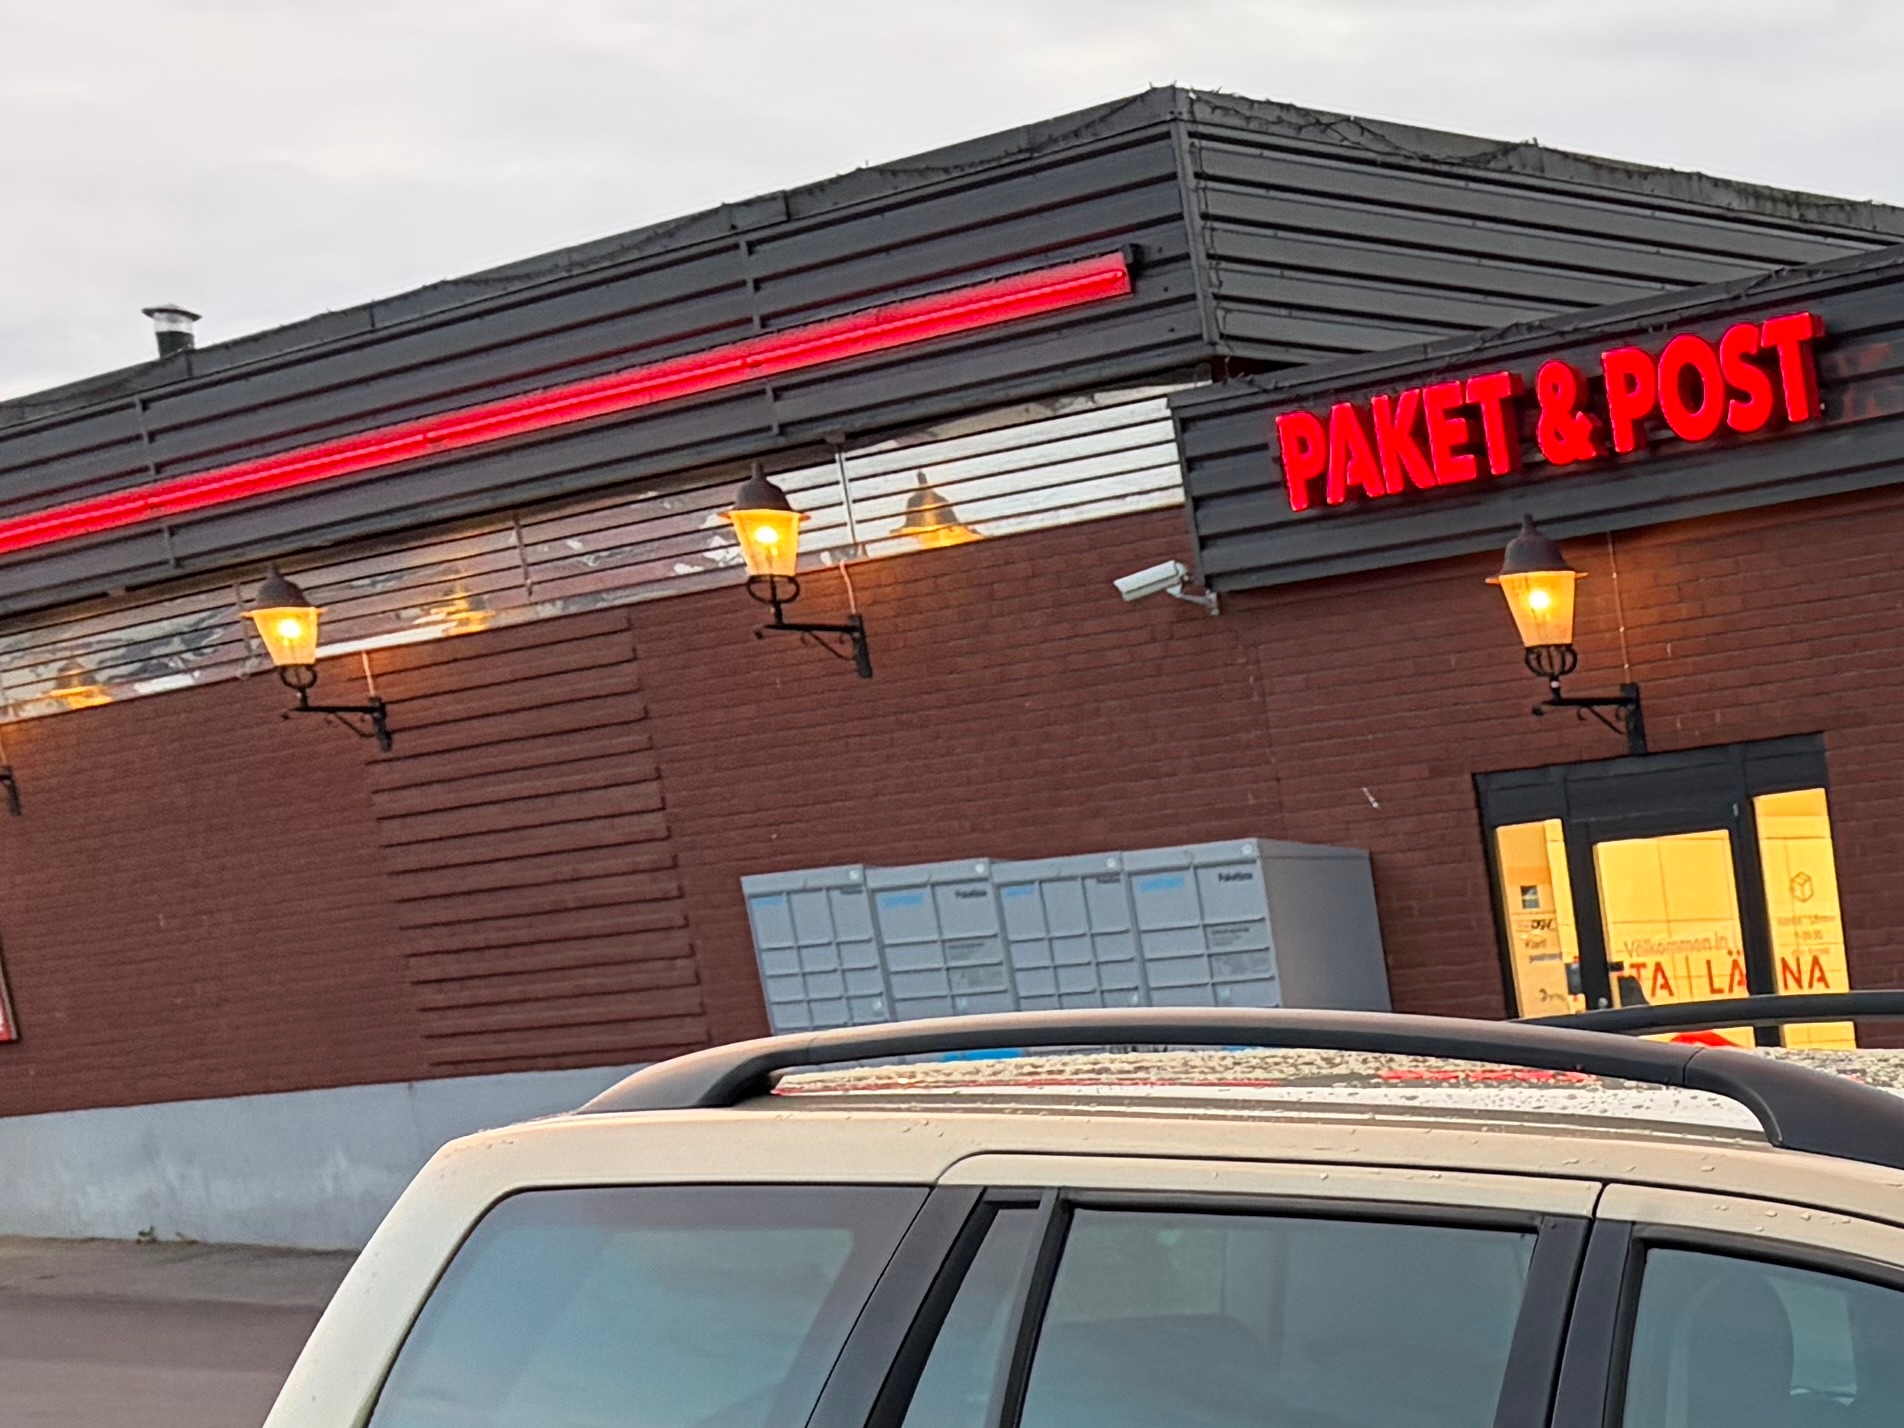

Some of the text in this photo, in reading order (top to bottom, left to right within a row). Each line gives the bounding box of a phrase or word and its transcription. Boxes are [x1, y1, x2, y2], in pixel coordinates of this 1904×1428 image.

[1275, 311, 1825, 511] PAKET & POST
